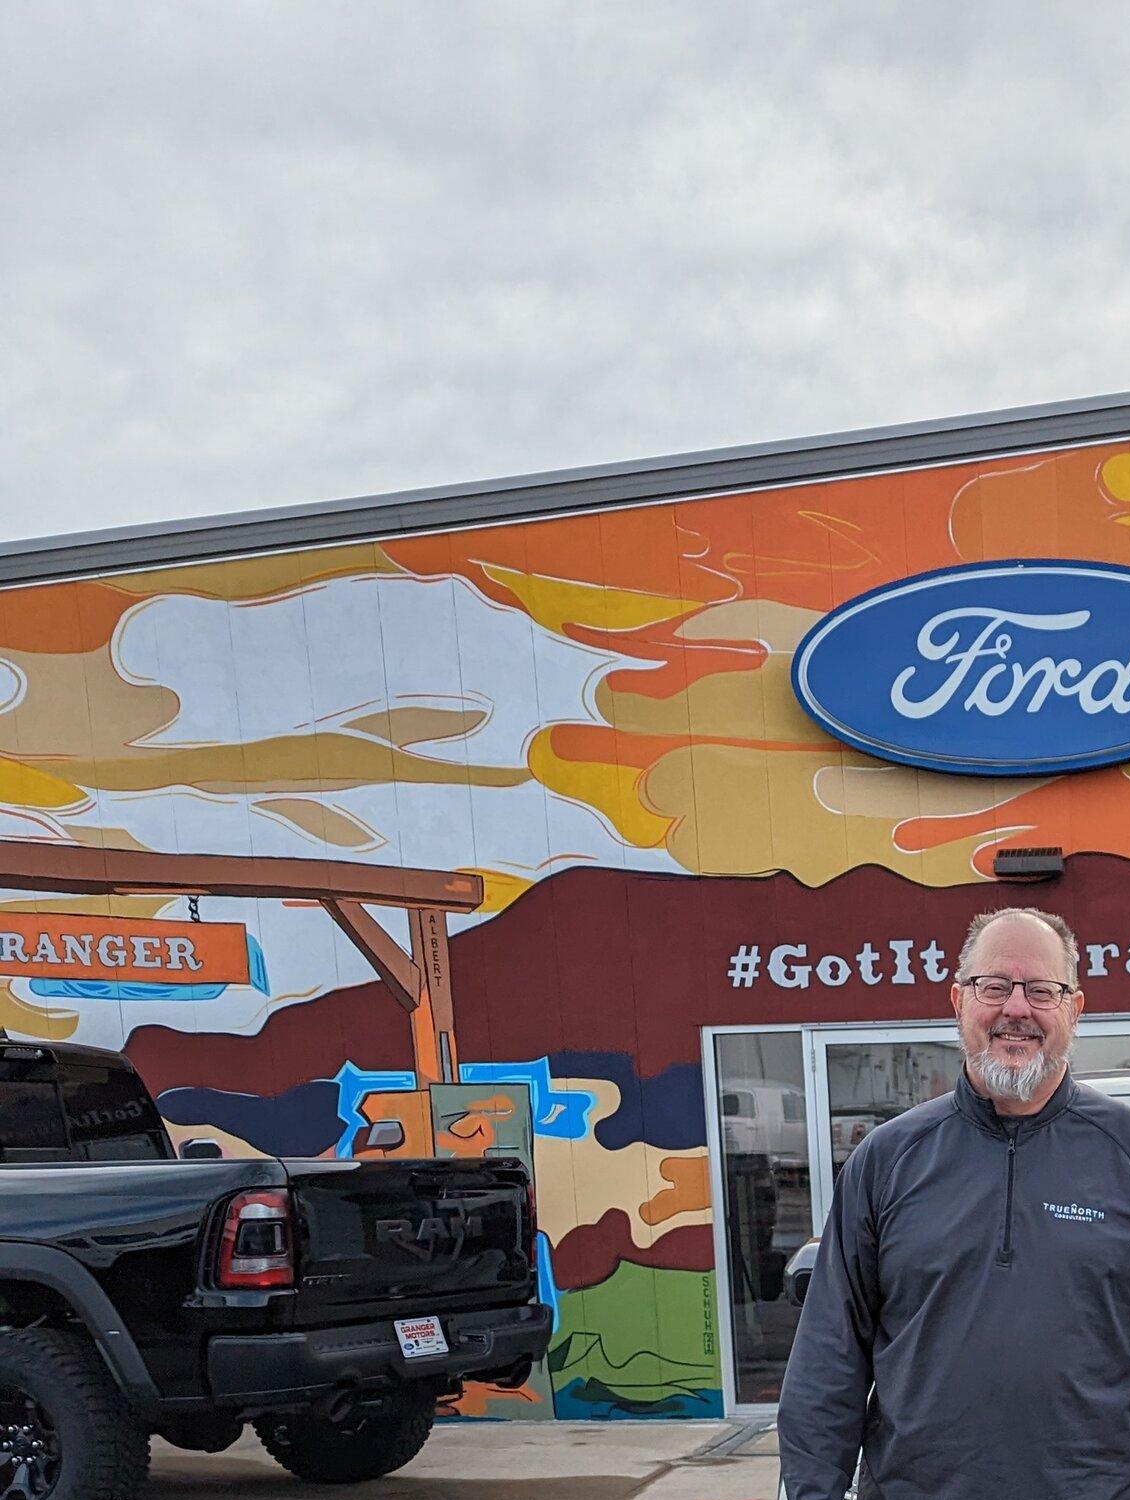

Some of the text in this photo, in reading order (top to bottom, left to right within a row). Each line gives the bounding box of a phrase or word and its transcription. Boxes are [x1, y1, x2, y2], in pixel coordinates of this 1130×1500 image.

[429, 914, 442, 987] ALBERT
[375, 1216, 484, 1243] RAM
[400, 1323, 436, 1334] GRANGER
[405, 1330, 436, 1340] MOTORS
